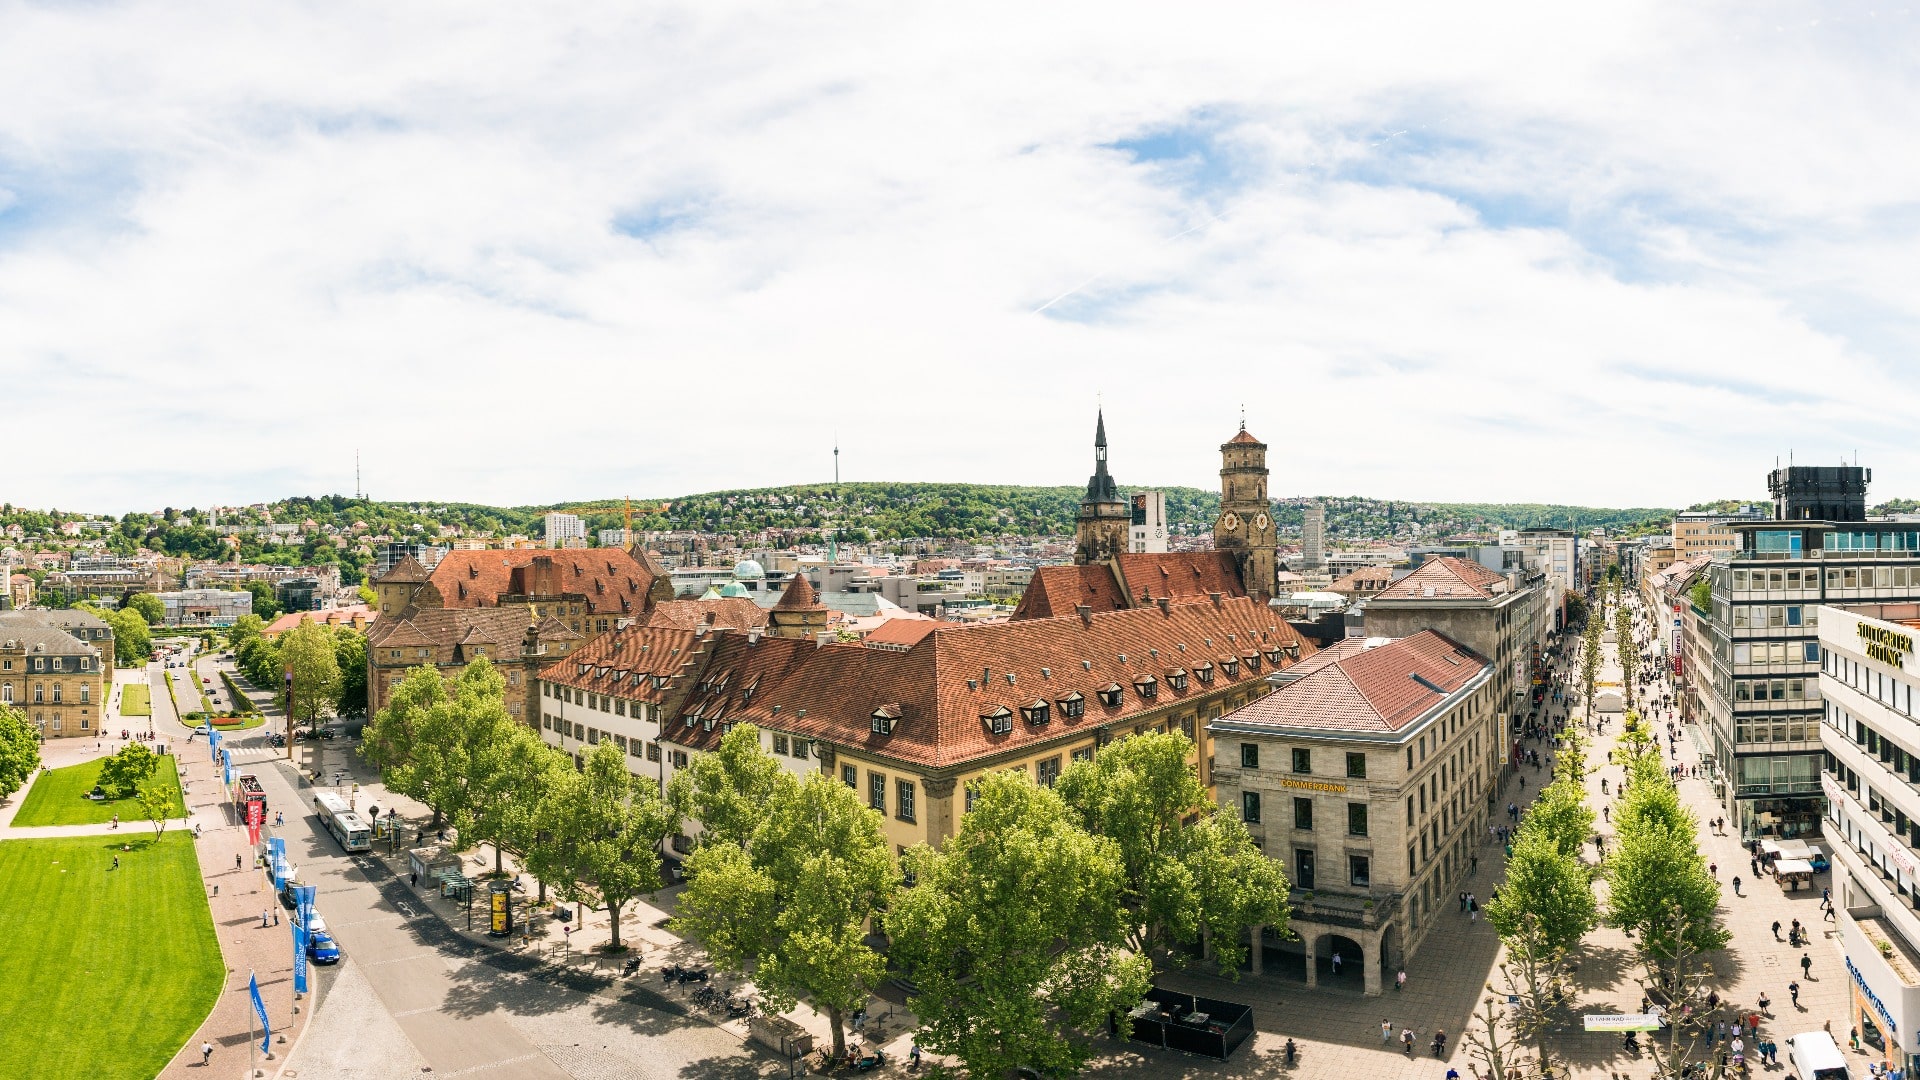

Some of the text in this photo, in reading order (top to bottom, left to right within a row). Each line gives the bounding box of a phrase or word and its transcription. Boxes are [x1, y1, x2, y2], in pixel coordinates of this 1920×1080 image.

[1857, 622, 1912, 653] STUTTGARTER
[1866, 642, 1902, 668] ZEITUNG
[1280, 779, 1347, 793] COMMERZBANK
